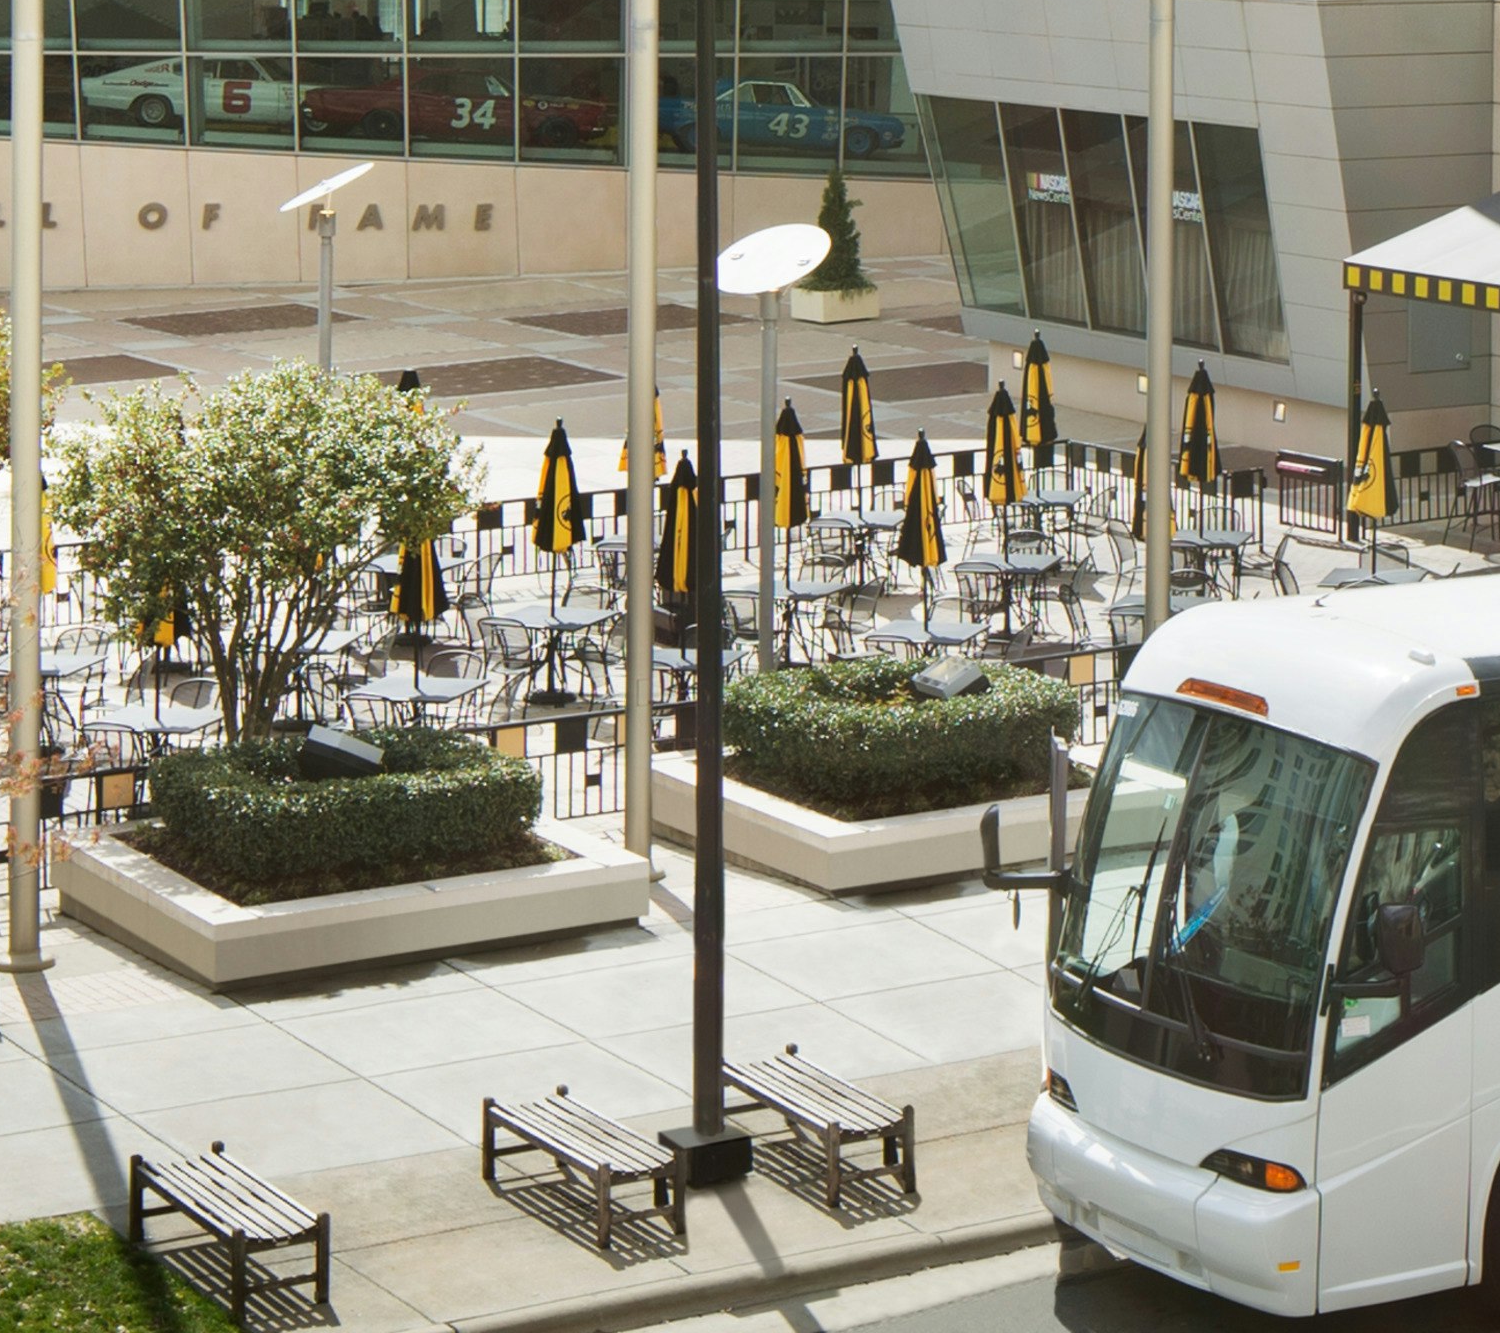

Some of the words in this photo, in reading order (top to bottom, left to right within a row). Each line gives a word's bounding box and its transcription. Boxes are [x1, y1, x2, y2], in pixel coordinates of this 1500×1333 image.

[222, 80, 253, 114] 6
[450, 97, 497, 130] 34
[768, 112, 810, 139] 43
[1028, 188, 1071, 205] NewsCente
[137, 201, 221, 232] OF
